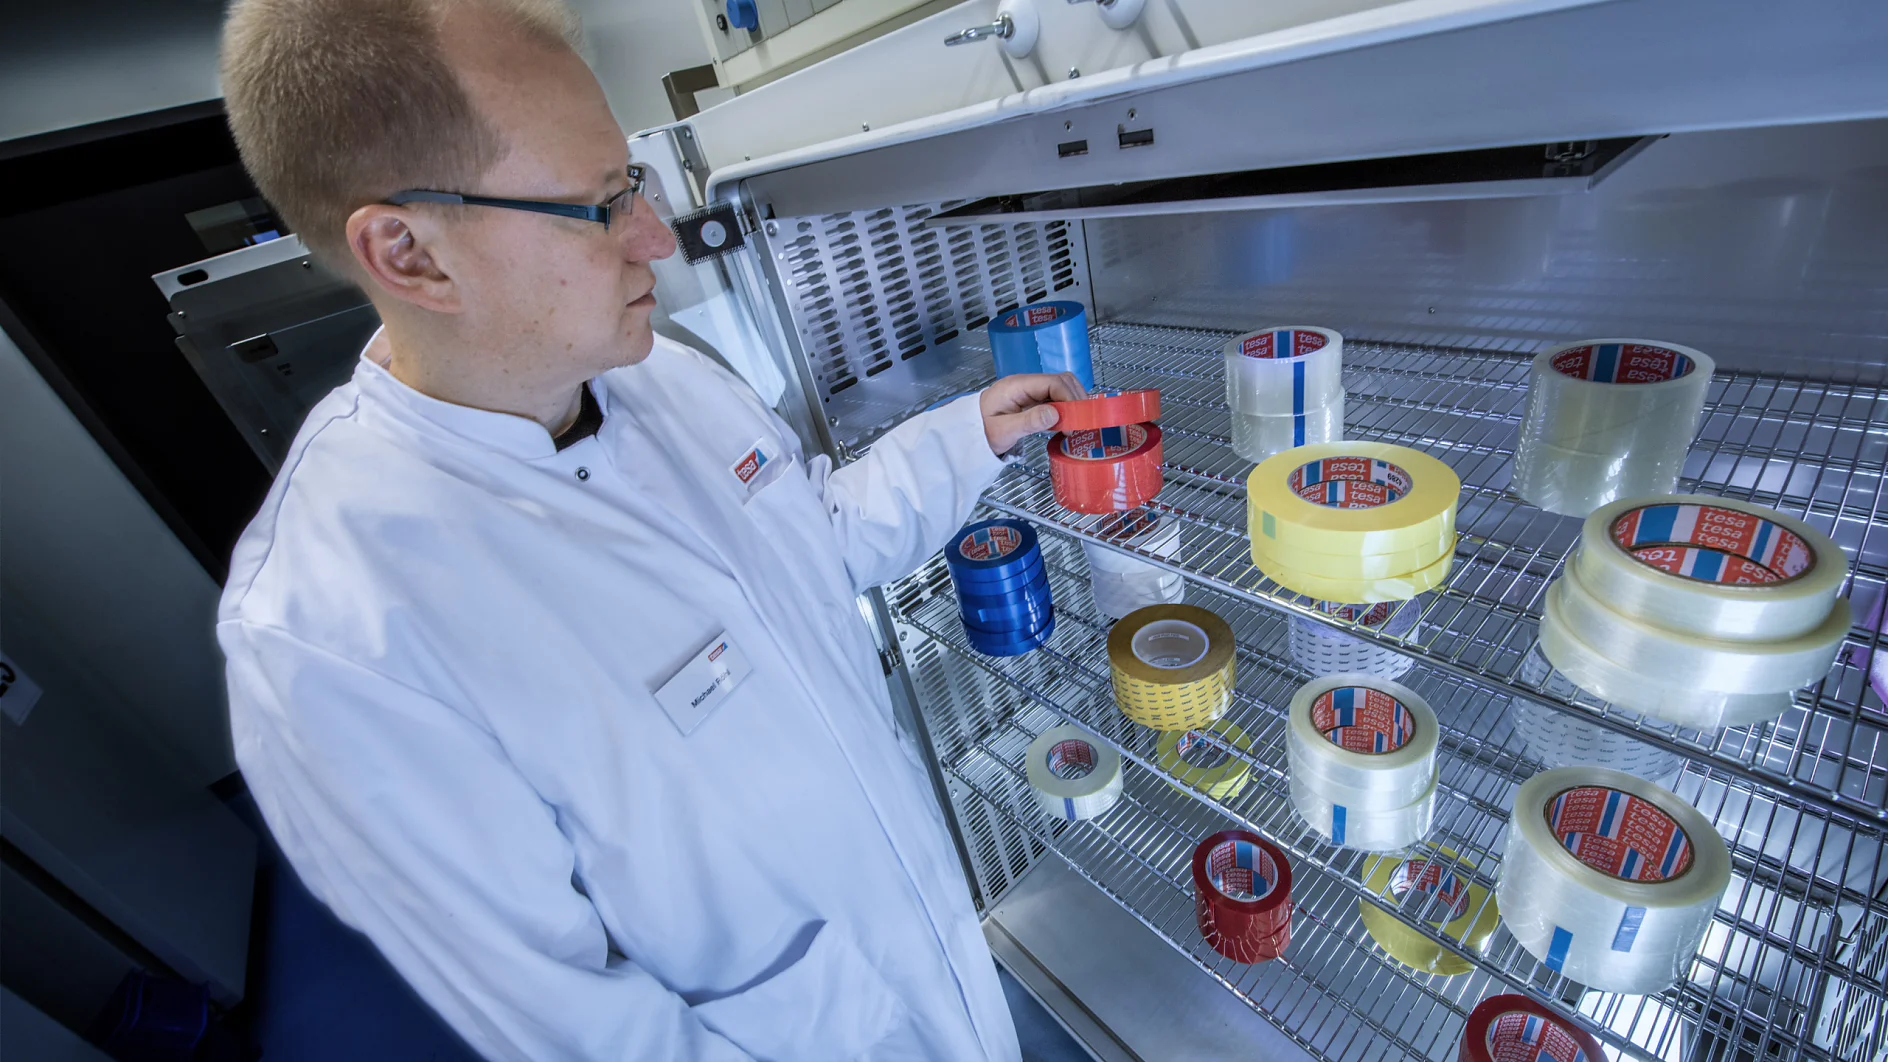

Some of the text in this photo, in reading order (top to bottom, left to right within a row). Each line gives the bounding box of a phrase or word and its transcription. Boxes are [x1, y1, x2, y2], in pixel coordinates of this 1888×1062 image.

[1245, 337, 1267, 350] tesa
[1298, 332, 1322, 346] tesa
[1629, 356, 1669, 373] tesa
[1071, 431, 1095, 447] tesa
[1072, 441, 1096, 456] tesa
[737, 459, 758, 481] tesa
[1331, 462, 1367, 472] tesa
[1300, 483, 1321, 496] tesa
[1351, 481, 1381, 494] tesa
[1350, 490, 1381, 504] tesa
[1704, 510, 1747, 529] tesa
[1701, 522, 1743, 540] tesa
[1697, 533, 1739, 550] tesa
[691, 682, 717, 708] Michael
[1369, 696, 1390, 707] tesa
[1368, 702, 1390, 713] tesa
[1632, 802, 1667, 828] tesa
[1630, 811, 1664, 836] tesa
[1624, 827, 1658, 852] tesa
[1627, 819, 1661, 845] tesa
[1584, 842, 1616, 856] tesa
[1586, 835, 1618, 850] tesa
[1622, 835, 1655, 860] tesa
[1580, 855, 1612, 869] tesa
[1582, 849, 1614, 863] tesa
